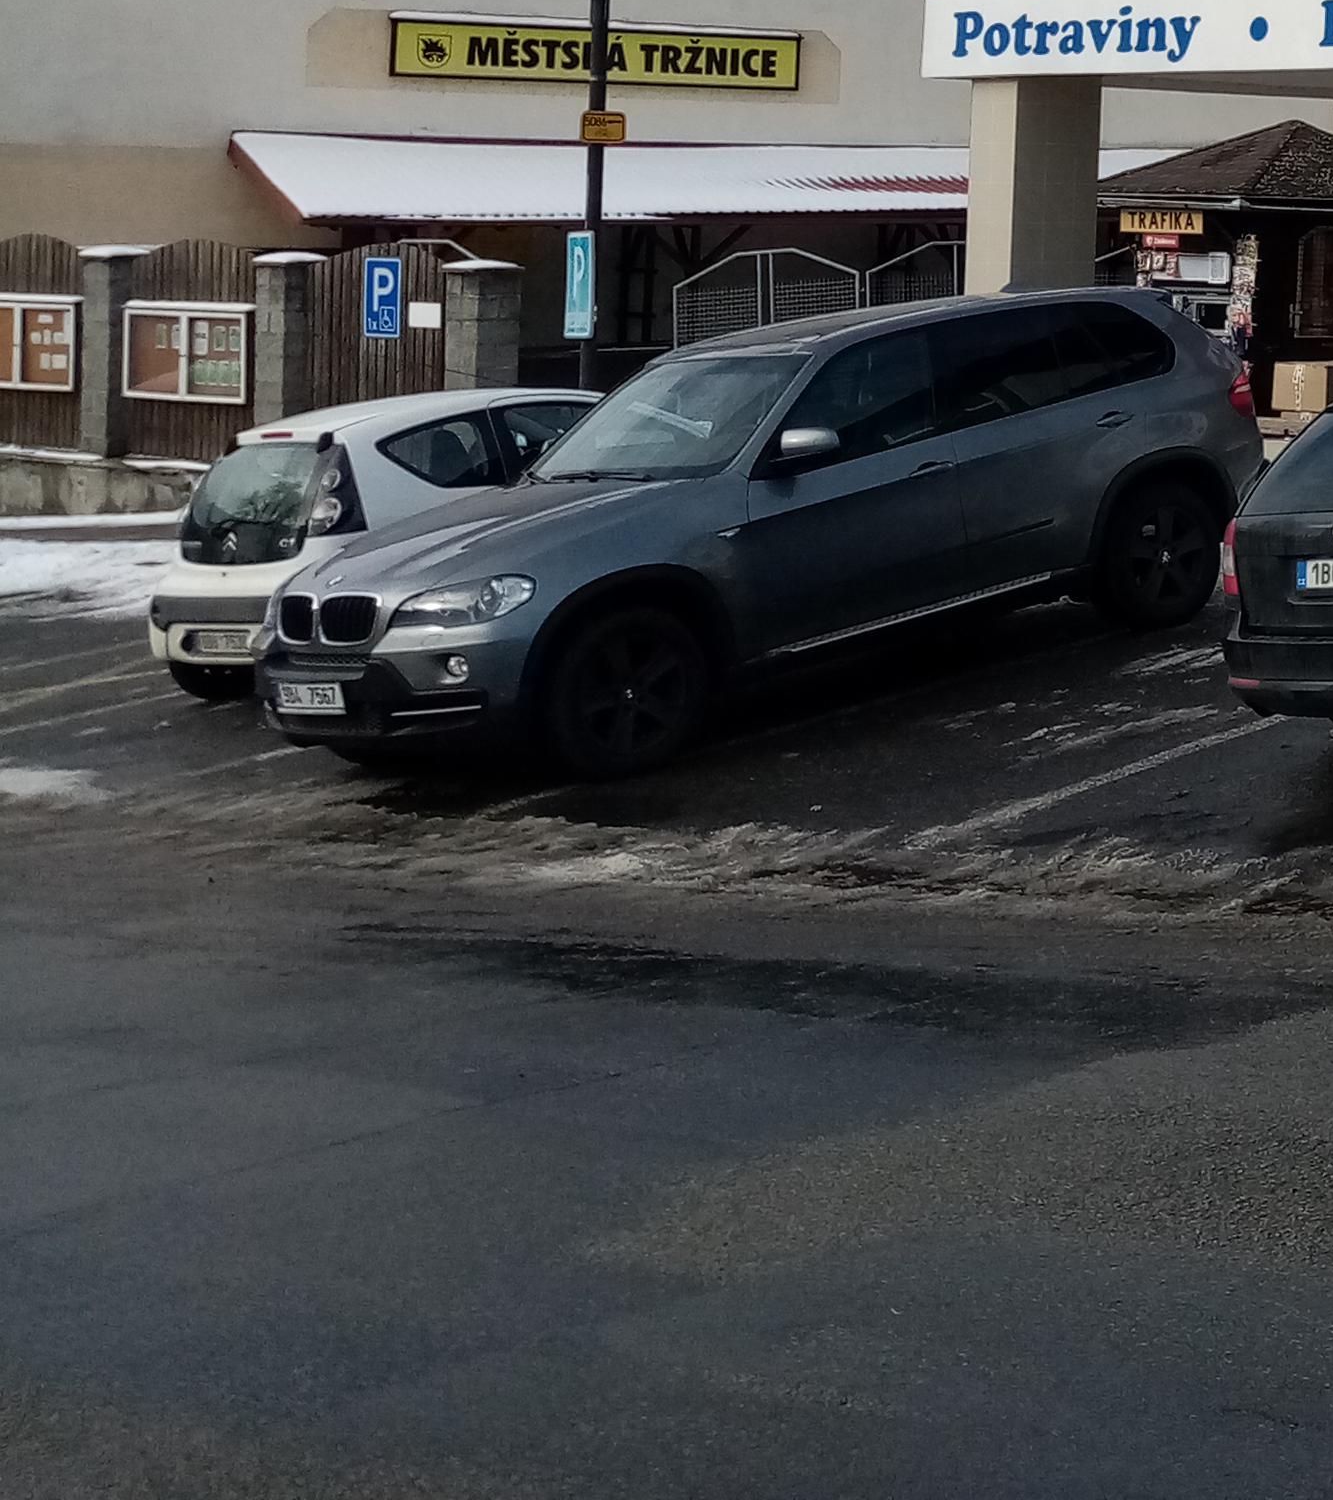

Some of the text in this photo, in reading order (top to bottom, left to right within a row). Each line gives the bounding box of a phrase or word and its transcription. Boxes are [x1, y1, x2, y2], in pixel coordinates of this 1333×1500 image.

[467, 30, 778, 78] MĚSTSÁ TRŽNICE
[953, 6, 1201, 63] Potraviny
[1127, 211, 1195, 231] TRAFIKA
[373, 267, 395, 312] P
